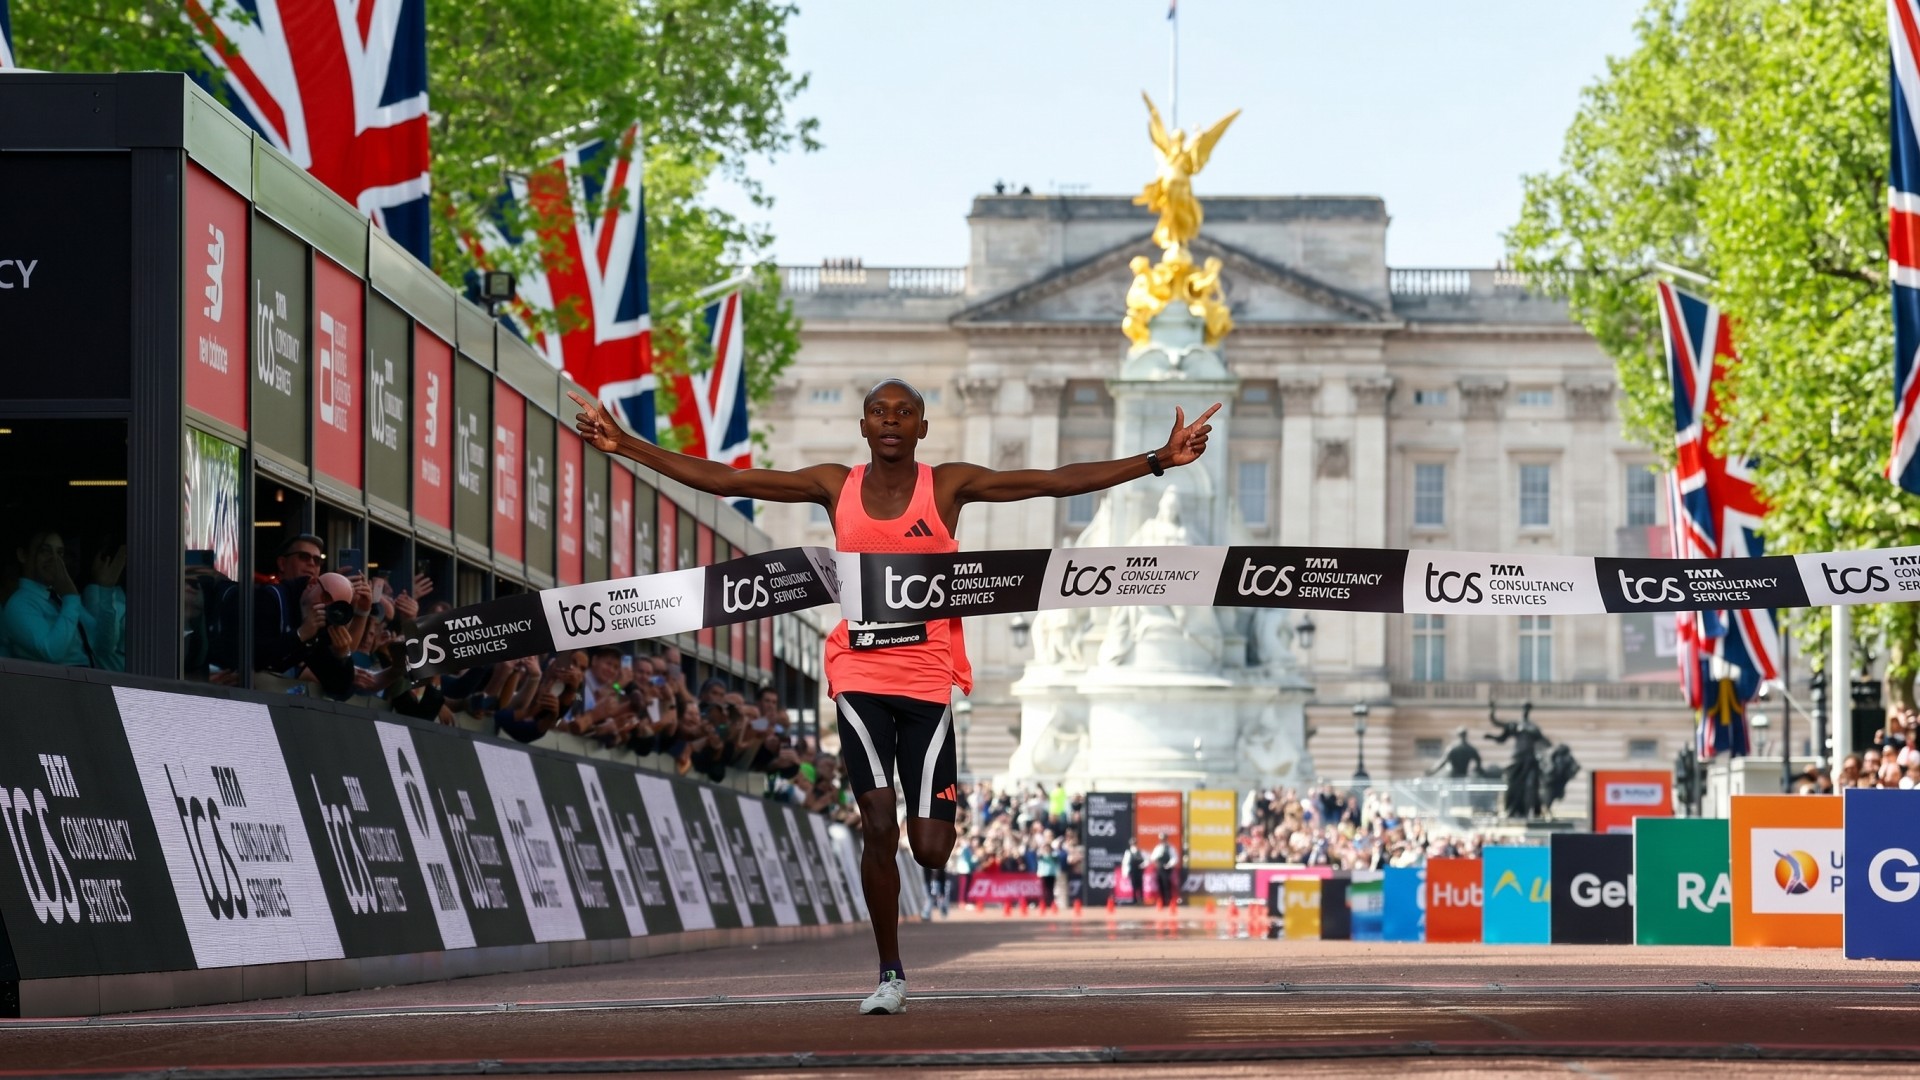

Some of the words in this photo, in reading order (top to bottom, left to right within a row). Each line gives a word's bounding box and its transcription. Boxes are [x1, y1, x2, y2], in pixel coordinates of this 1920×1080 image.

[0, 260, 38, 288] CY
[257, 279, 275, 387] tcs
[765, 561, 787, 574] TATA
[953, 562, 983, 575] TATA
[1125, 557, 1158, 568] TATA
[1305, 557, 1338, 569] TATA
[1490, 564, 1525, 576] TATA
[1889, 555, 1920, 566] TAT
[951, 575, 1025, 591] CONSULTANCY
[1060, 559, 1116, 597] tcs
[1120, 570, 1200, 582] CONSULTANCY
[1237, 557, 1295, 597] tcs
[1301, 571, 1382, 585] CONSULTANCY
[1425, 562, 1484, 603] tcs
[1684, 568, 1724, 579] TATA
[1822, 562, 1890, 595] tcs
[608, 588, 639, 601] TATA
[723, 574, 769, 613] tcs
[885, 566, 946, 610] tcs
[1116, 584, 1166, 595] SERVICES
[1298, 586, 1351, 600] SERVICES
[1489, 579, 1575, 592] CONSULTANCY
[1618, 569, 1686, 604] tcs
[1689, 578, 1778, 591] CONSULTANCY
[609, 596, 683, 616] CONSULTANCY
[950, 592, 995, 607] SERVICES
[1491, 594, 1547, 605] SERVICES
[1693, 591, 1751, 602] SERVICES
[445, 615, 483, 631] TATA
[558, 599, 606, 637] tcs
[611, 614, 657, 631] SERVICES
[449, 619, 532, 645] CONSULTANCY
[875, 637, 890, 645] new
[891, 635, 920, 644] balance
[405, 634, 445, 670] cs
[452, 638, 508, 659] SERVICES
[38, 754, 80, 798] TATA
[211, 766, 247, 808] TATA
[1088, 817, 1116, 836] tcs
[60, 816, 137, 861] CONSULTANCY
[164, 764, 248, 921] tcs
[230, 822, 293, 863] CONSULTANCY
[311, 773, 378, 915] tcs
[0, 784, 81, 924] tcs
[1831, 851, 1844, 869] U
[1831, 875, 1844, 893] P
[1868, 848, 1920, 903] G
[79, 878, 132, 923] SERVICES
[246, 878, 292, 918] SERVICES
[1432, 882, 1482, 907] Hub
[1678, 872, 1731, 914] RA
